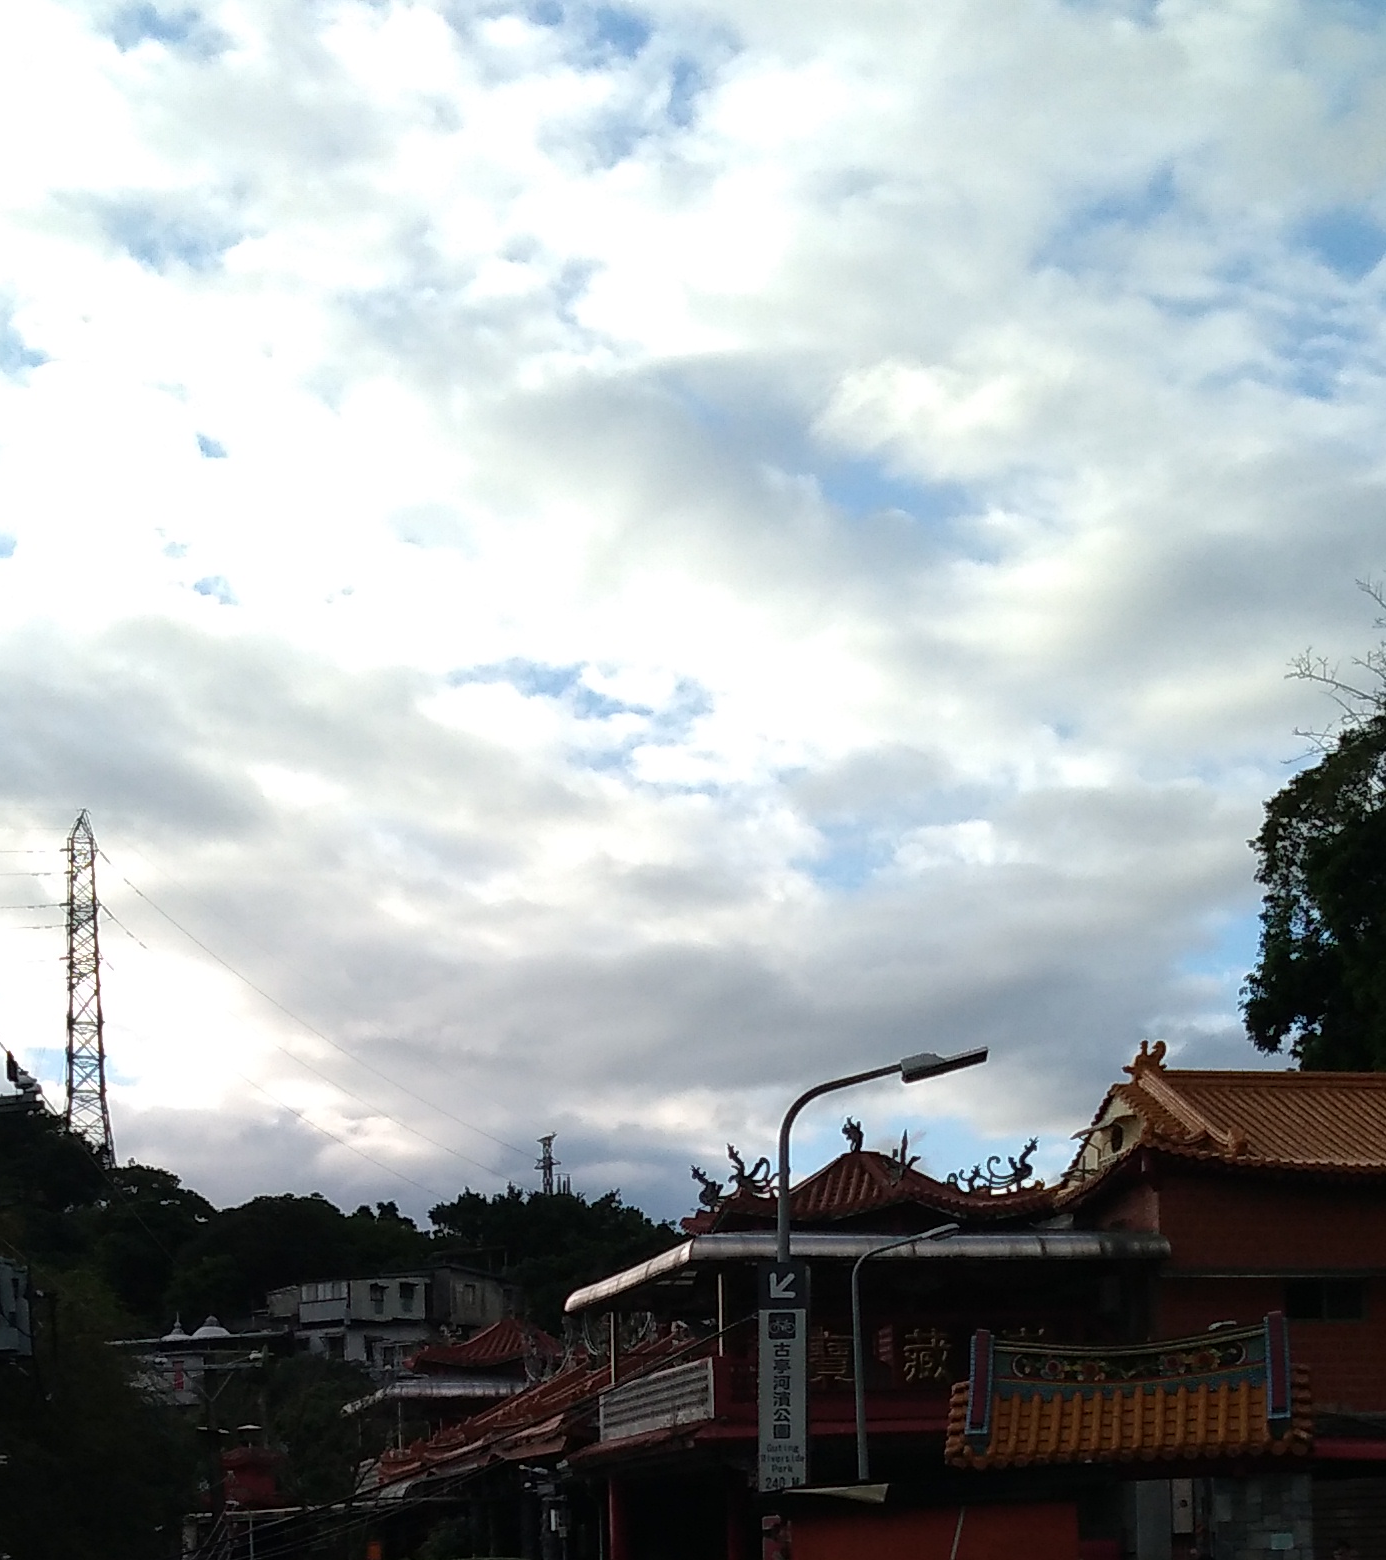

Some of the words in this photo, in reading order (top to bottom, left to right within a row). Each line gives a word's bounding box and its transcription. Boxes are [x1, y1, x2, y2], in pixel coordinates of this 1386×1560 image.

[773, 1342, 791, 1439] 古亭河濱公園
[771, 1464, 793, 1473] Park
